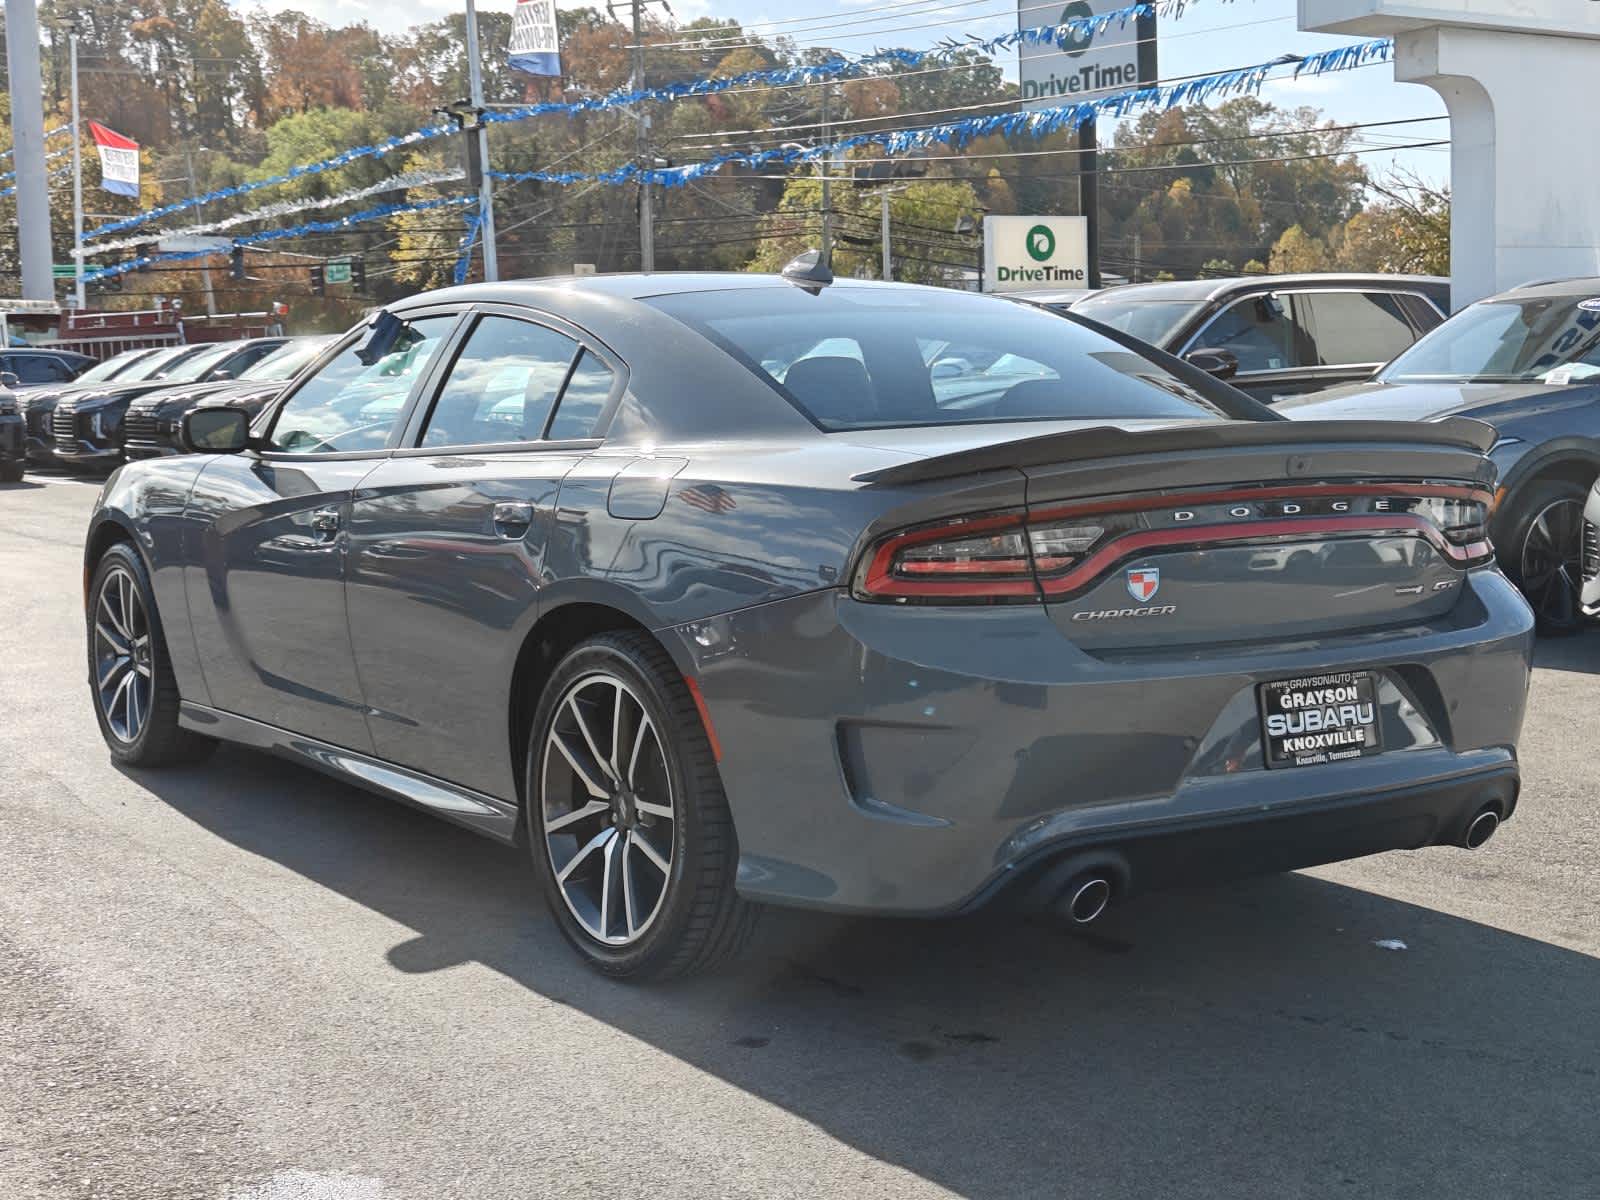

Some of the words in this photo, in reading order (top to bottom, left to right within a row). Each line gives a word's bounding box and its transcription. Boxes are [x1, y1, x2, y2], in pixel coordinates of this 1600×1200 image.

[1023, 62, 1137, 100] DriveTime
[997, 266, 1084, 281] DriveTime
[1174, 500, 1390, 521] DODGE
[1071, 605, 1177, 621] CHARGER
[1280, 686, 1358, 709] GRAYSON
[1267, 702, 1374, 736] SUBARU
[1283, 729, 1364, 752] KNOXVILLE
